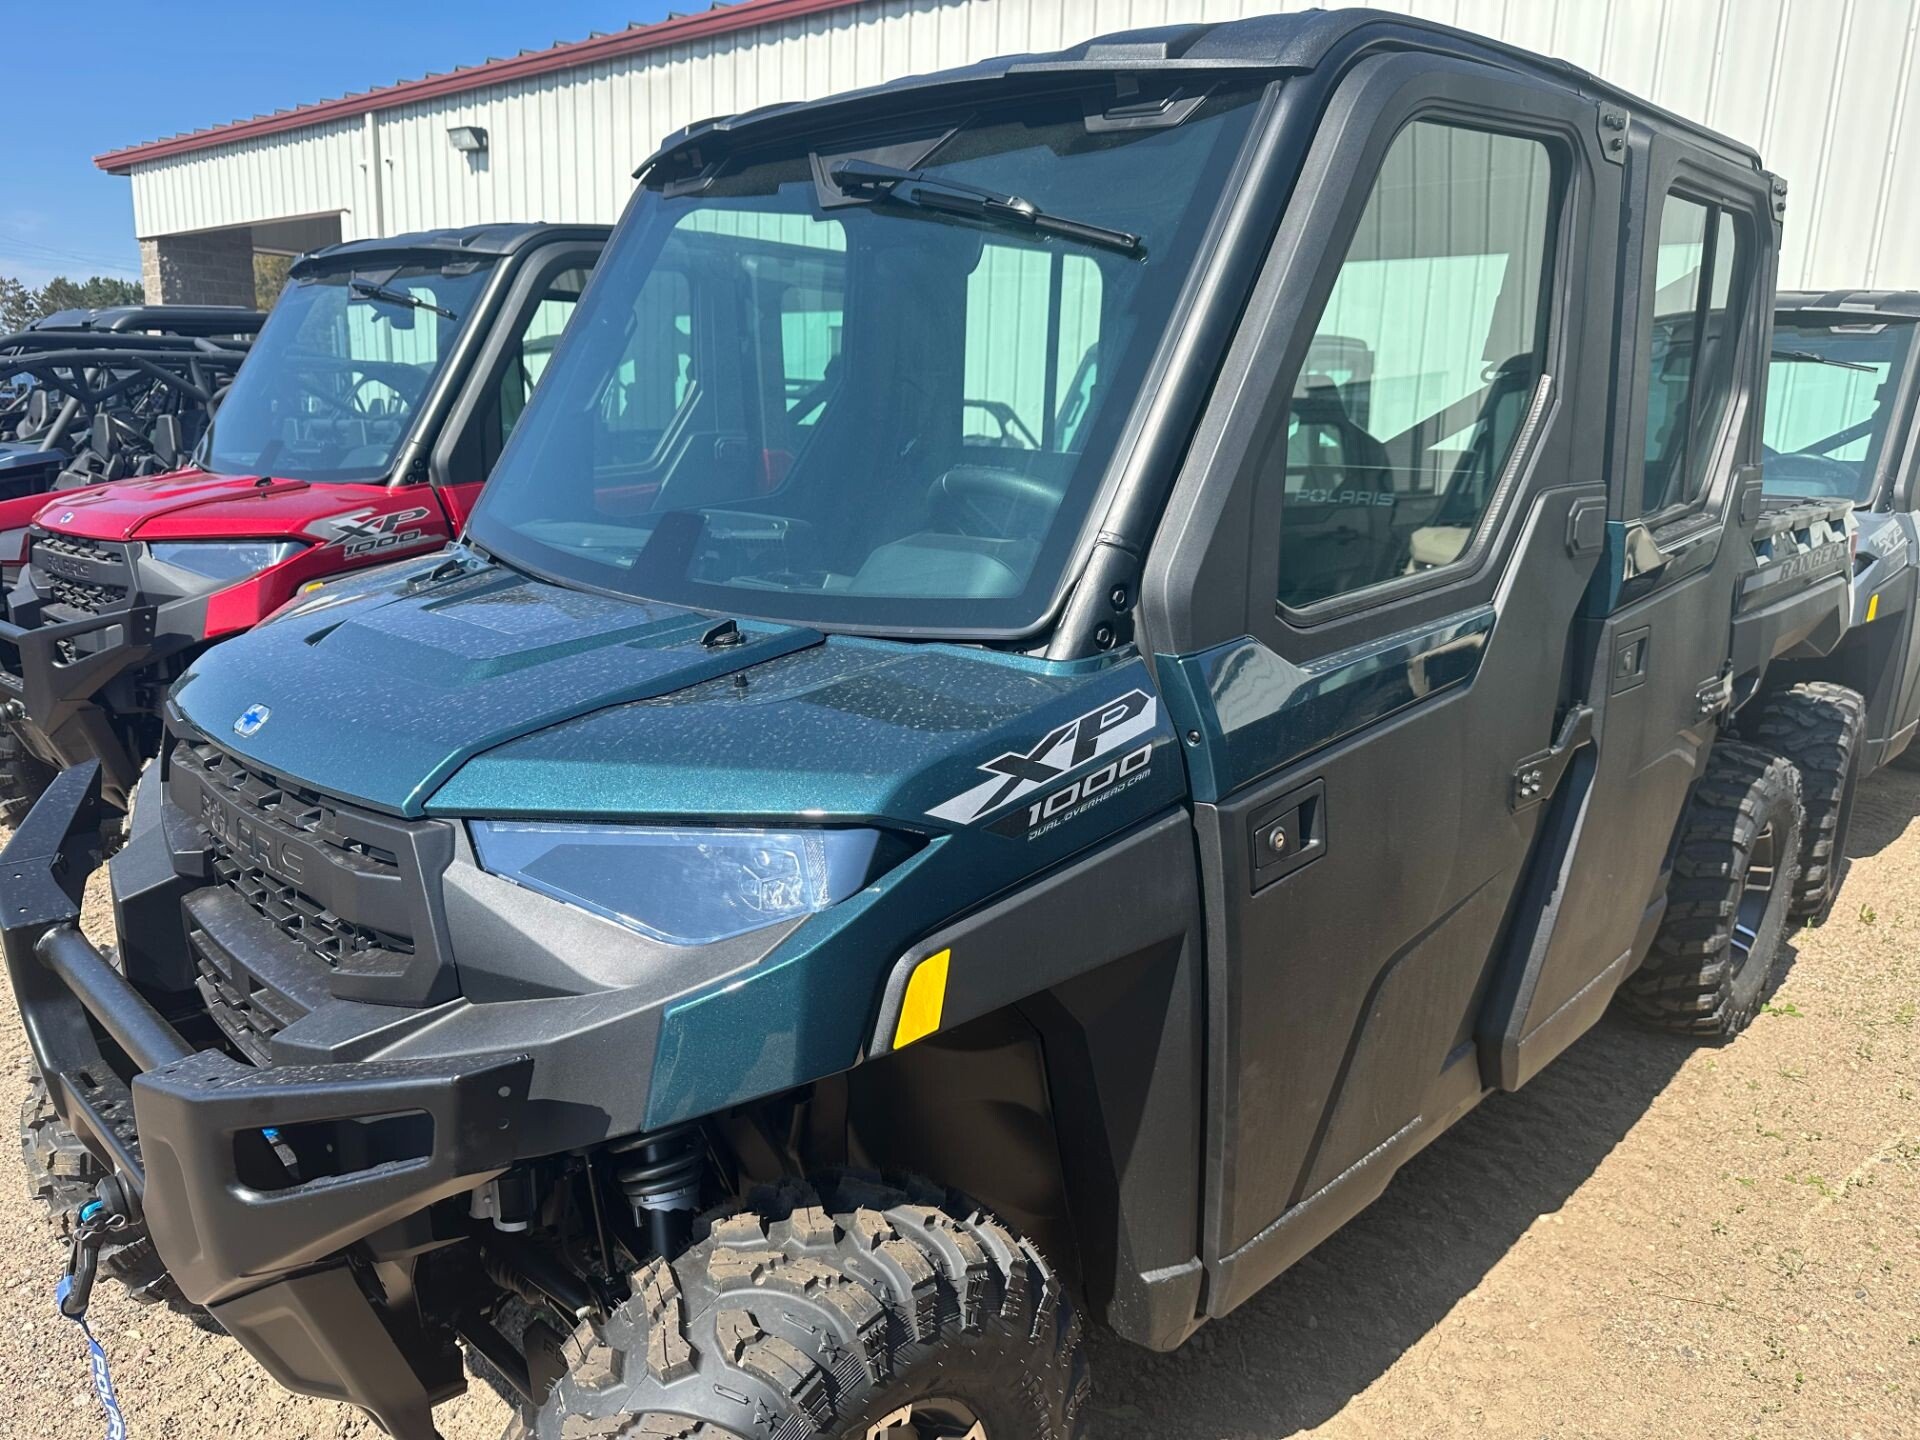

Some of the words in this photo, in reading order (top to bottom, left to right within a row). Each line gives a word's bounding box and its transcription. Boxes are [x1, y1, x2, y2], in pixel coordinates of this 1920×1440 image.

[1295, 487, 1395, 507] POLARIS
[321, 506, 431, 549] XP
[343, 528, 422, 557] 1000
[1880, 525, 1904, 557] XP
[1778, 543, 1840, 582] RANGER
[967, 688, 1153, 824] XP
[1027, 818, 1062, 843] DUAL
[1063, 782, 1126, 822] OVERHEAD
[1126, 767, 1152, 787] CAM
[1028, 743, 1153, 828] 1000
[200, 788, 304, 886] POLARIS
